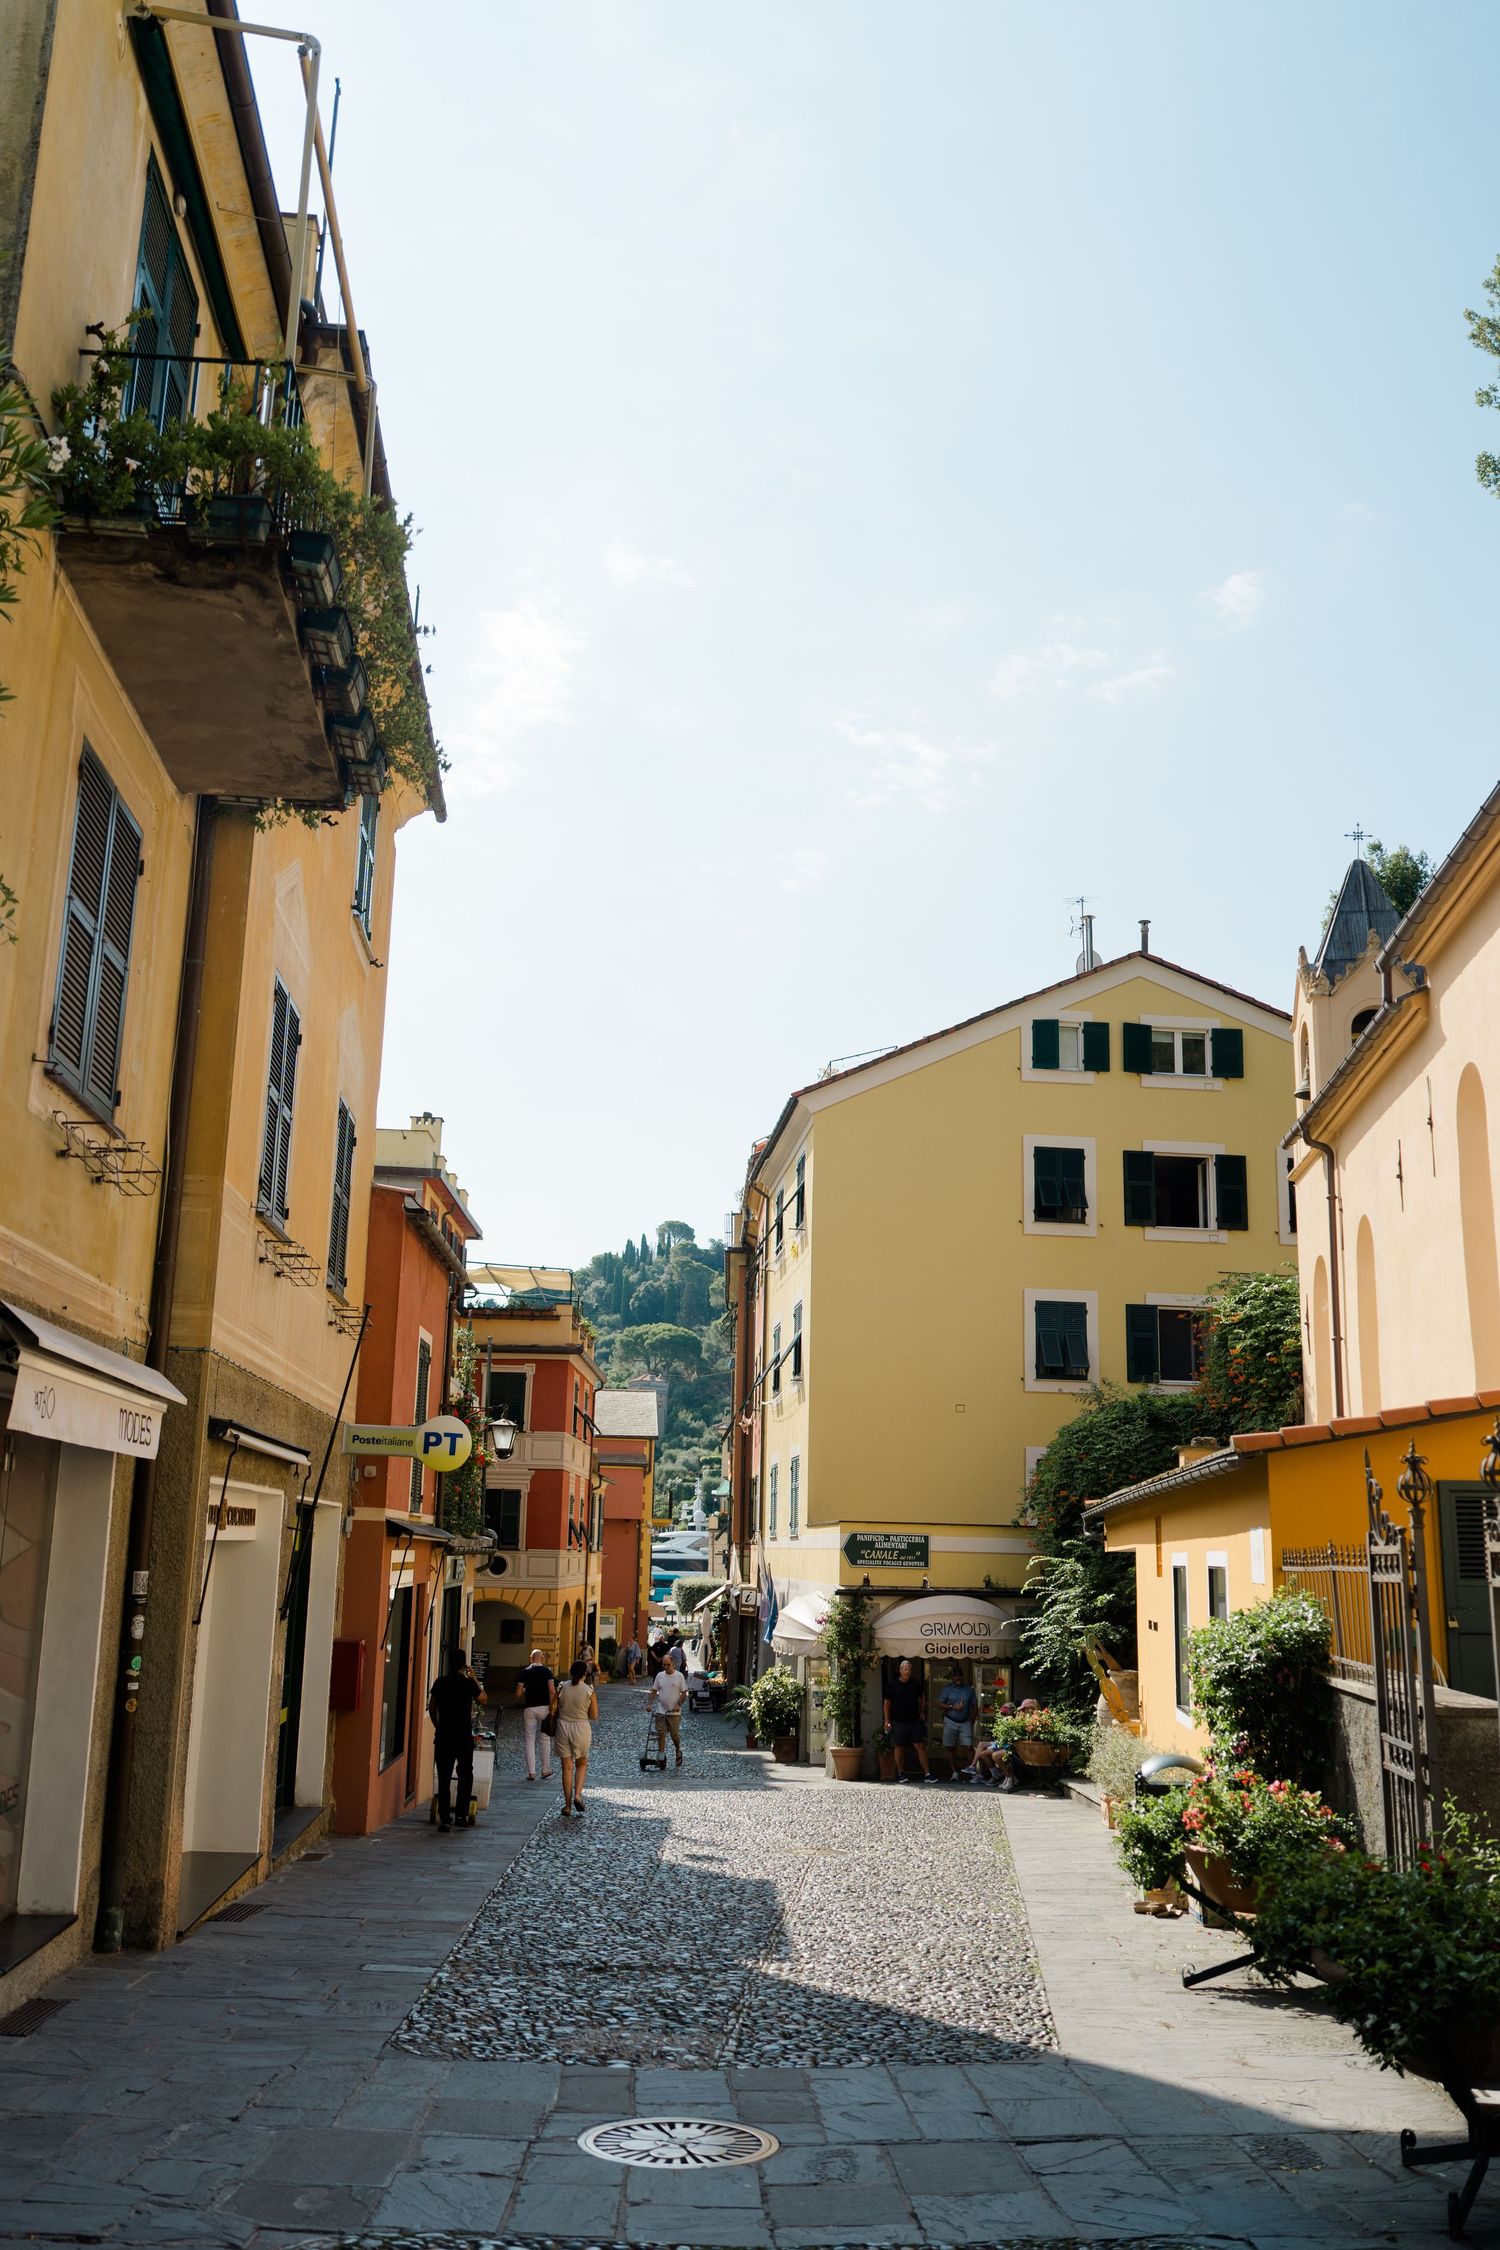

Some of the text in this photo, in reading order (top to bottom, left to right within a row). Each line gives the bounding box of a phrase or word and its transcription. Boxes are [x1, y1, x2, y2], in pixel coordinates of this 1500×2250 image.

[118, 1408, 152, 1446] MODES
[351, 1434, 414, 1447] Posteitaliane
[422, 1431, 464, 1456] PT
[920, 1622, 991, 1637] GRIMOLDI
[925, 1642, 990, 1655] Gioielleria
